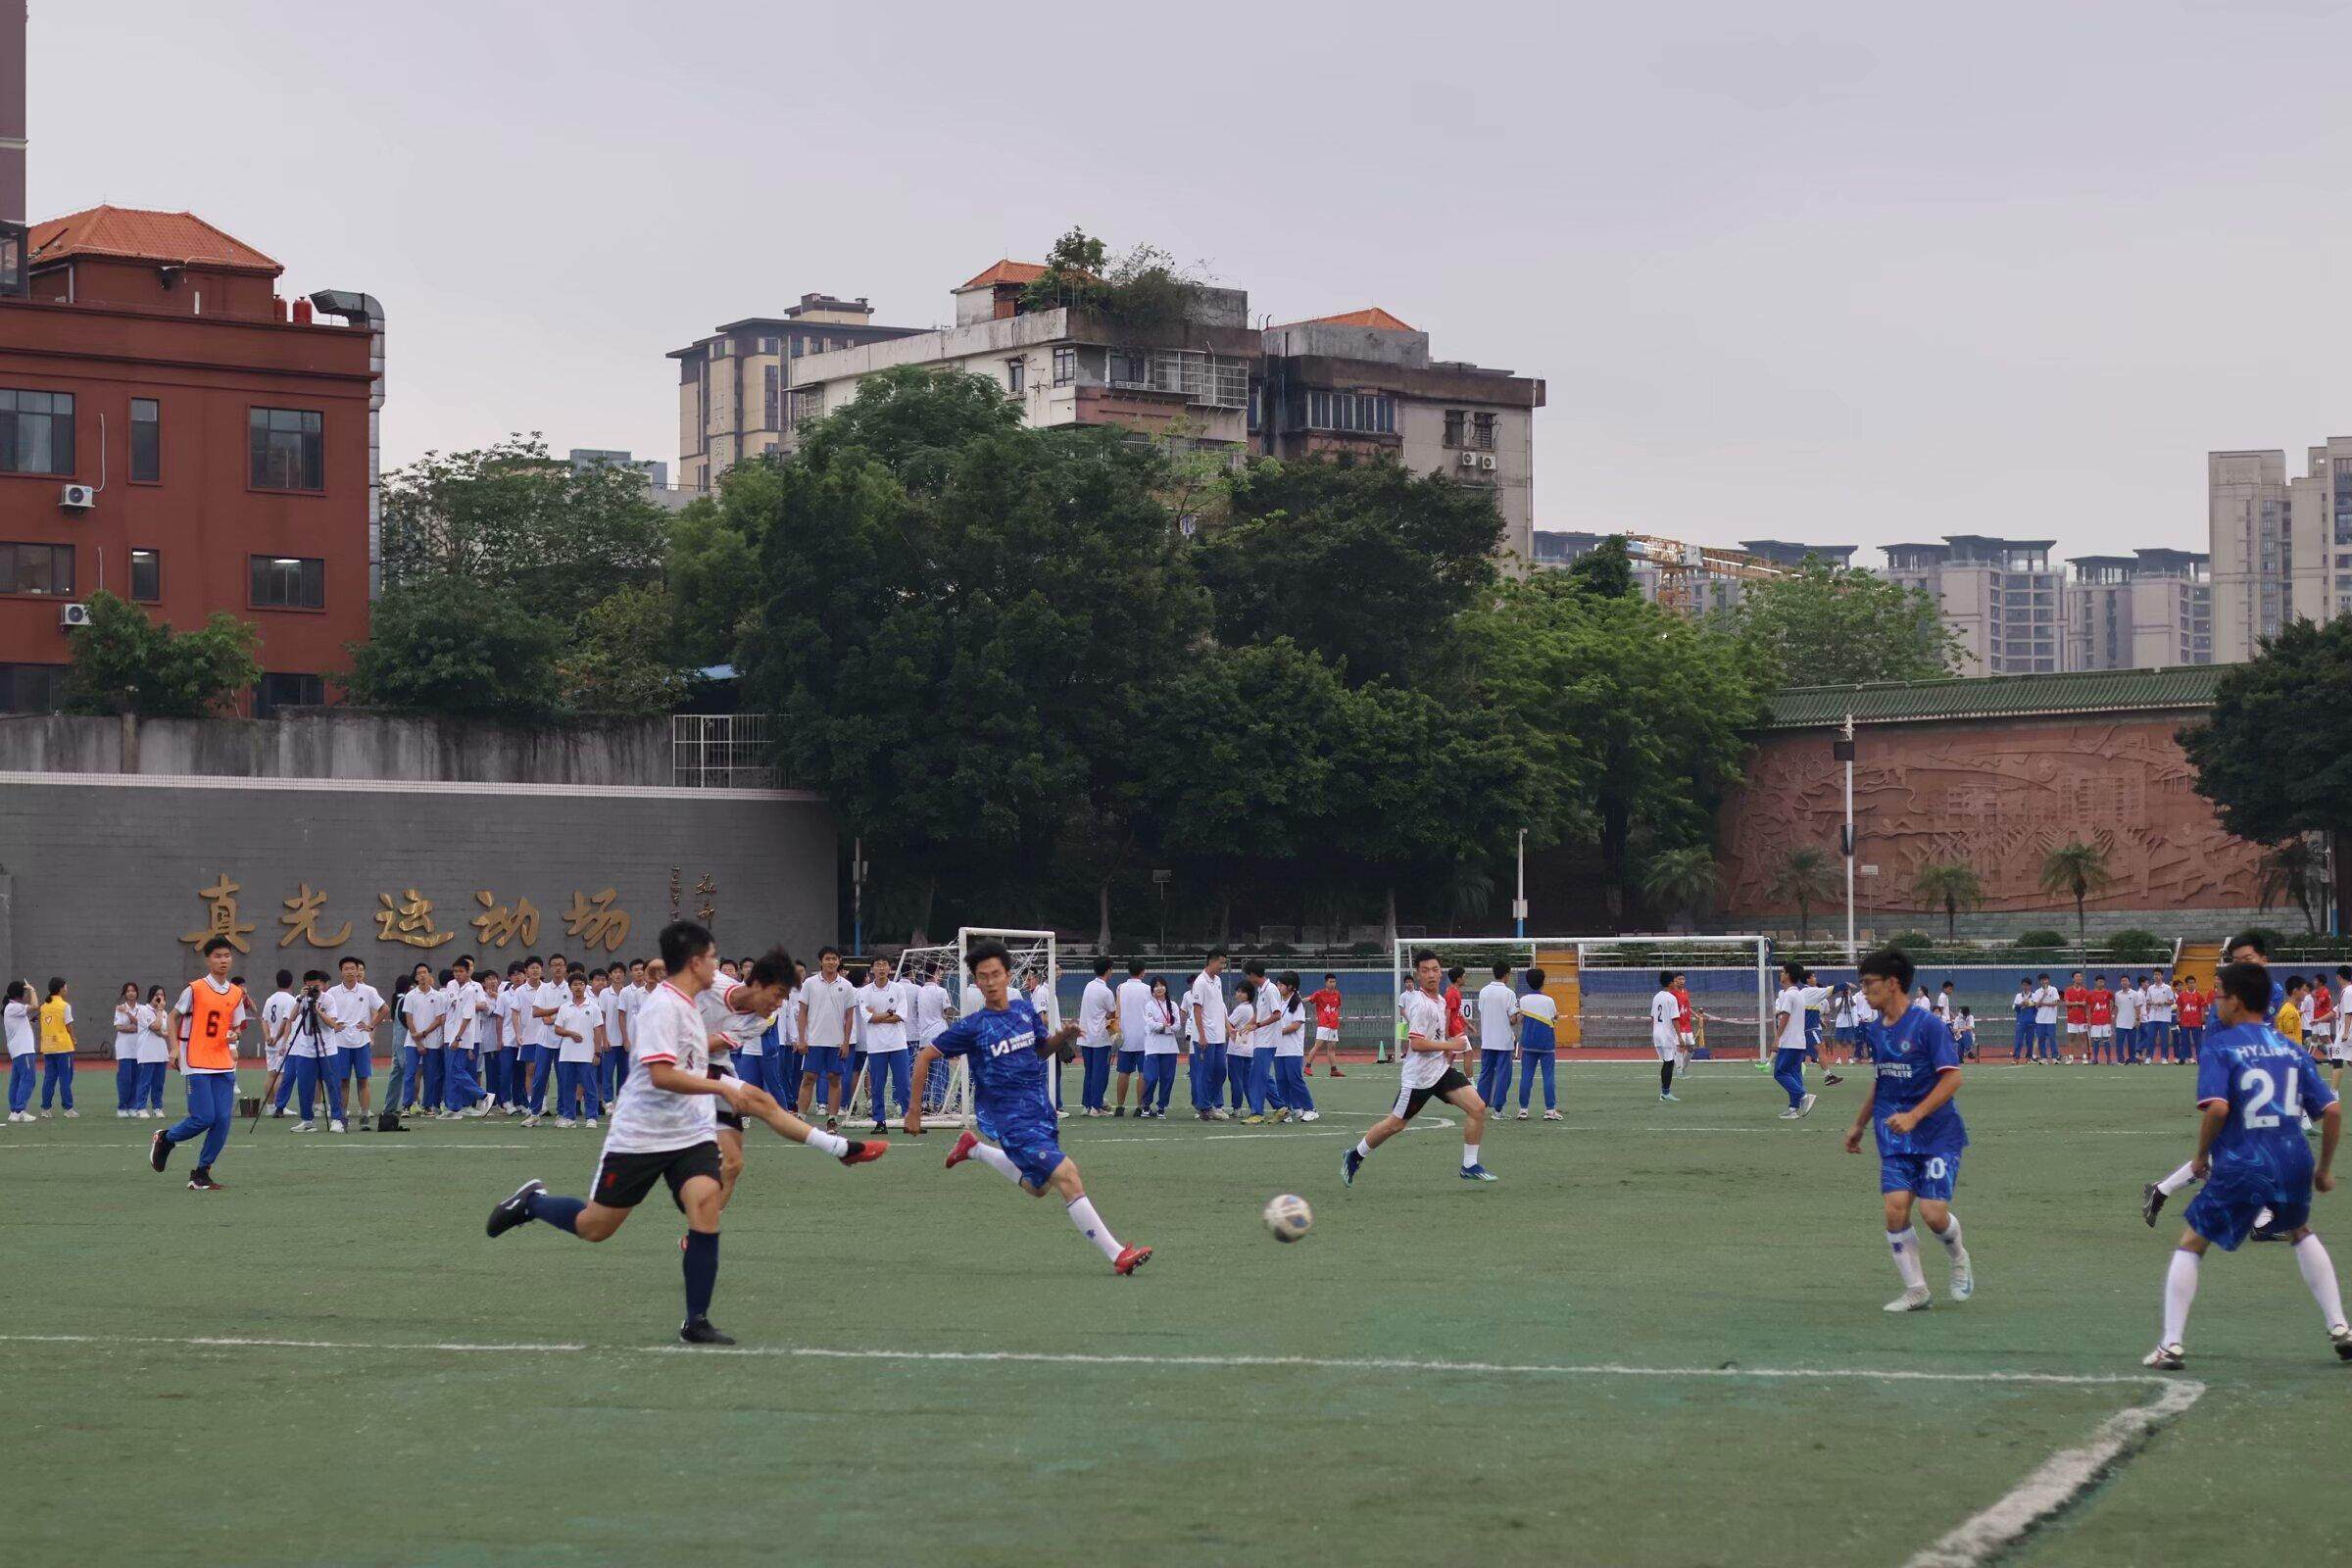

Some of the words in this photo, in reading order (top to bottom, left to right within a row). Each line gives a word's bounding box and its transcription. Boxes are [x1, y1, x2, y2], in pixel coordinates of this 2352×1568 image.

[177, 872, 632, 954] 真光运动场
[206, 1009, 220, 1037] 6
[270, 1004, 278, 1023] 8
[1657, 1004, 1664, 1023] 2
